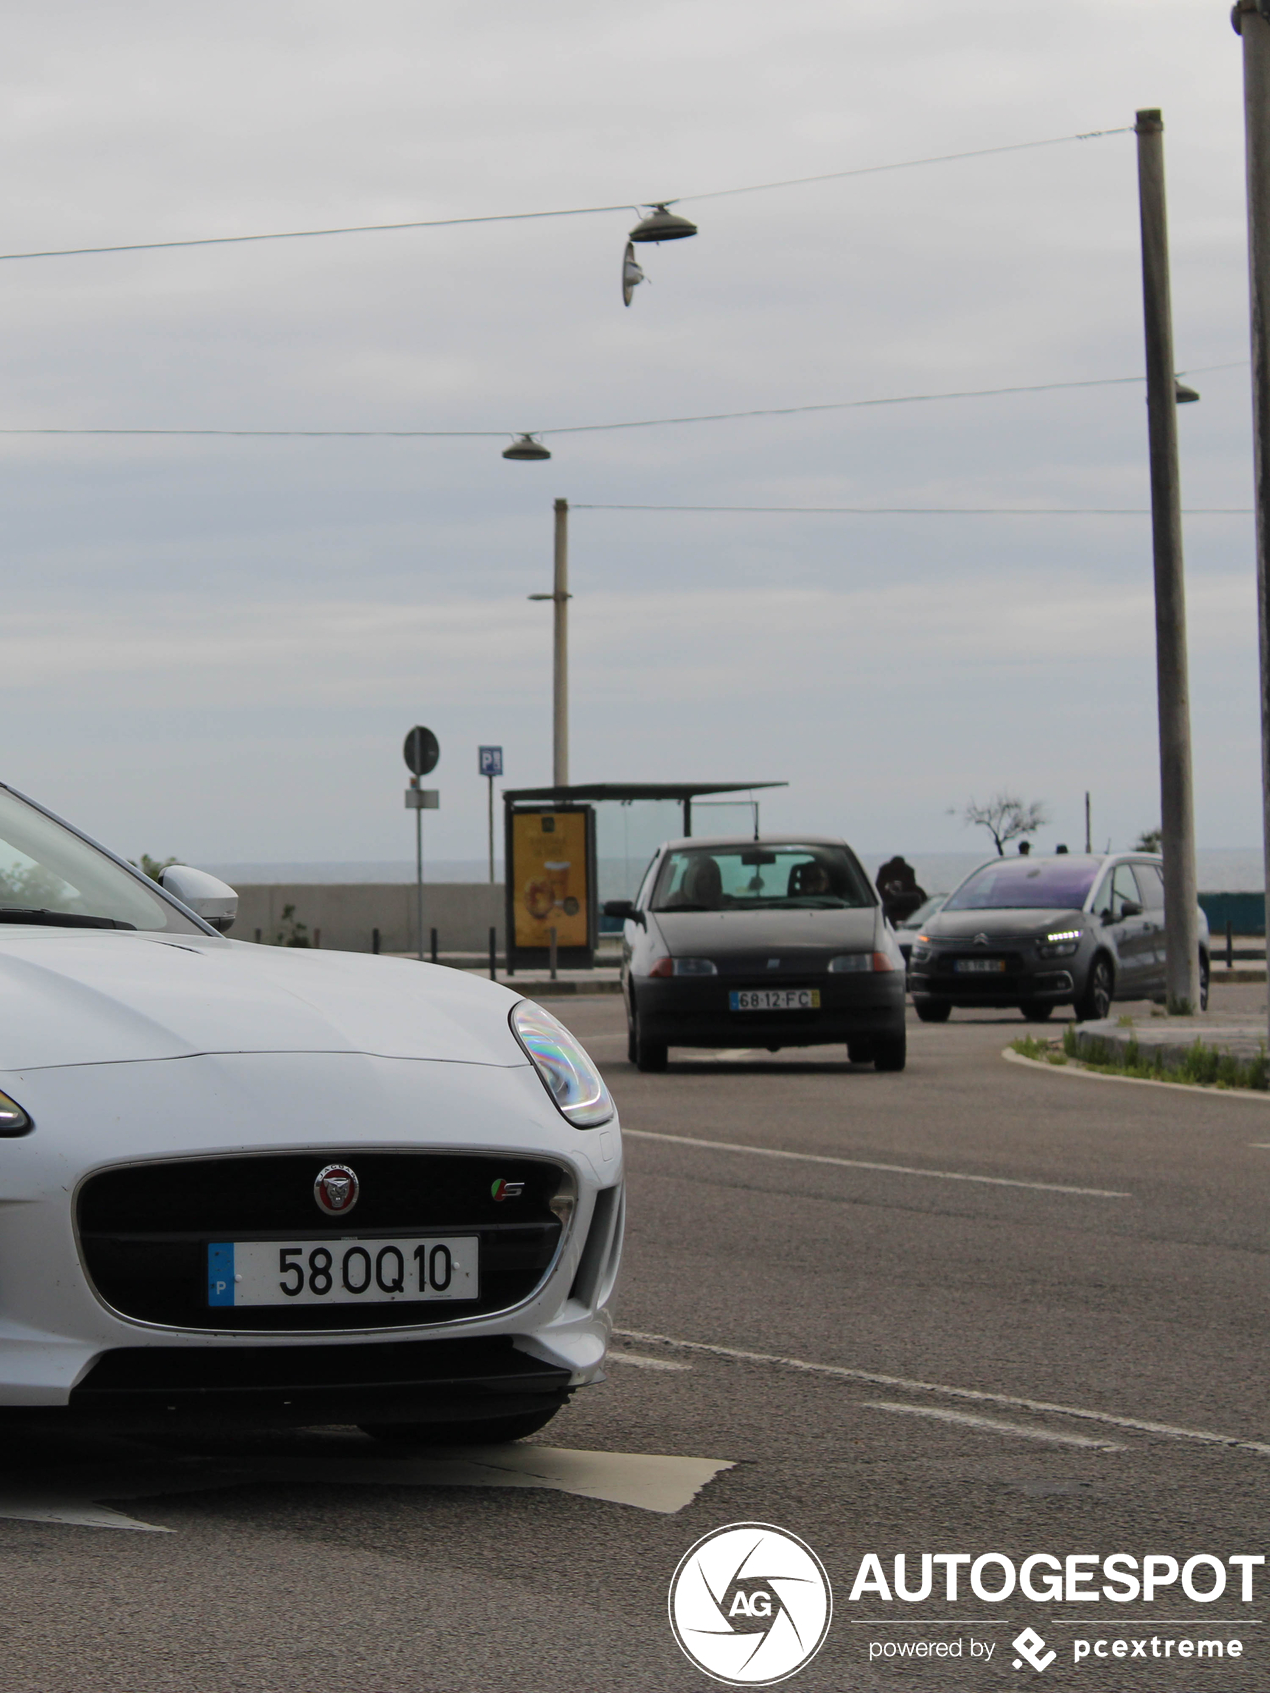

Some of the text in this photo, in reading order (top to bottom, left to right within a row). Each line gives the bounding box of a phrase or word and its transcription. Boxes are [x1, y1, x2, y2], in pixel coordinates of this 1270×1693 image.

[482, 752, 492, 769] P
[319, 1164, 357, 1181] JAGUAR
[216, 1281, 226, 1295] P
